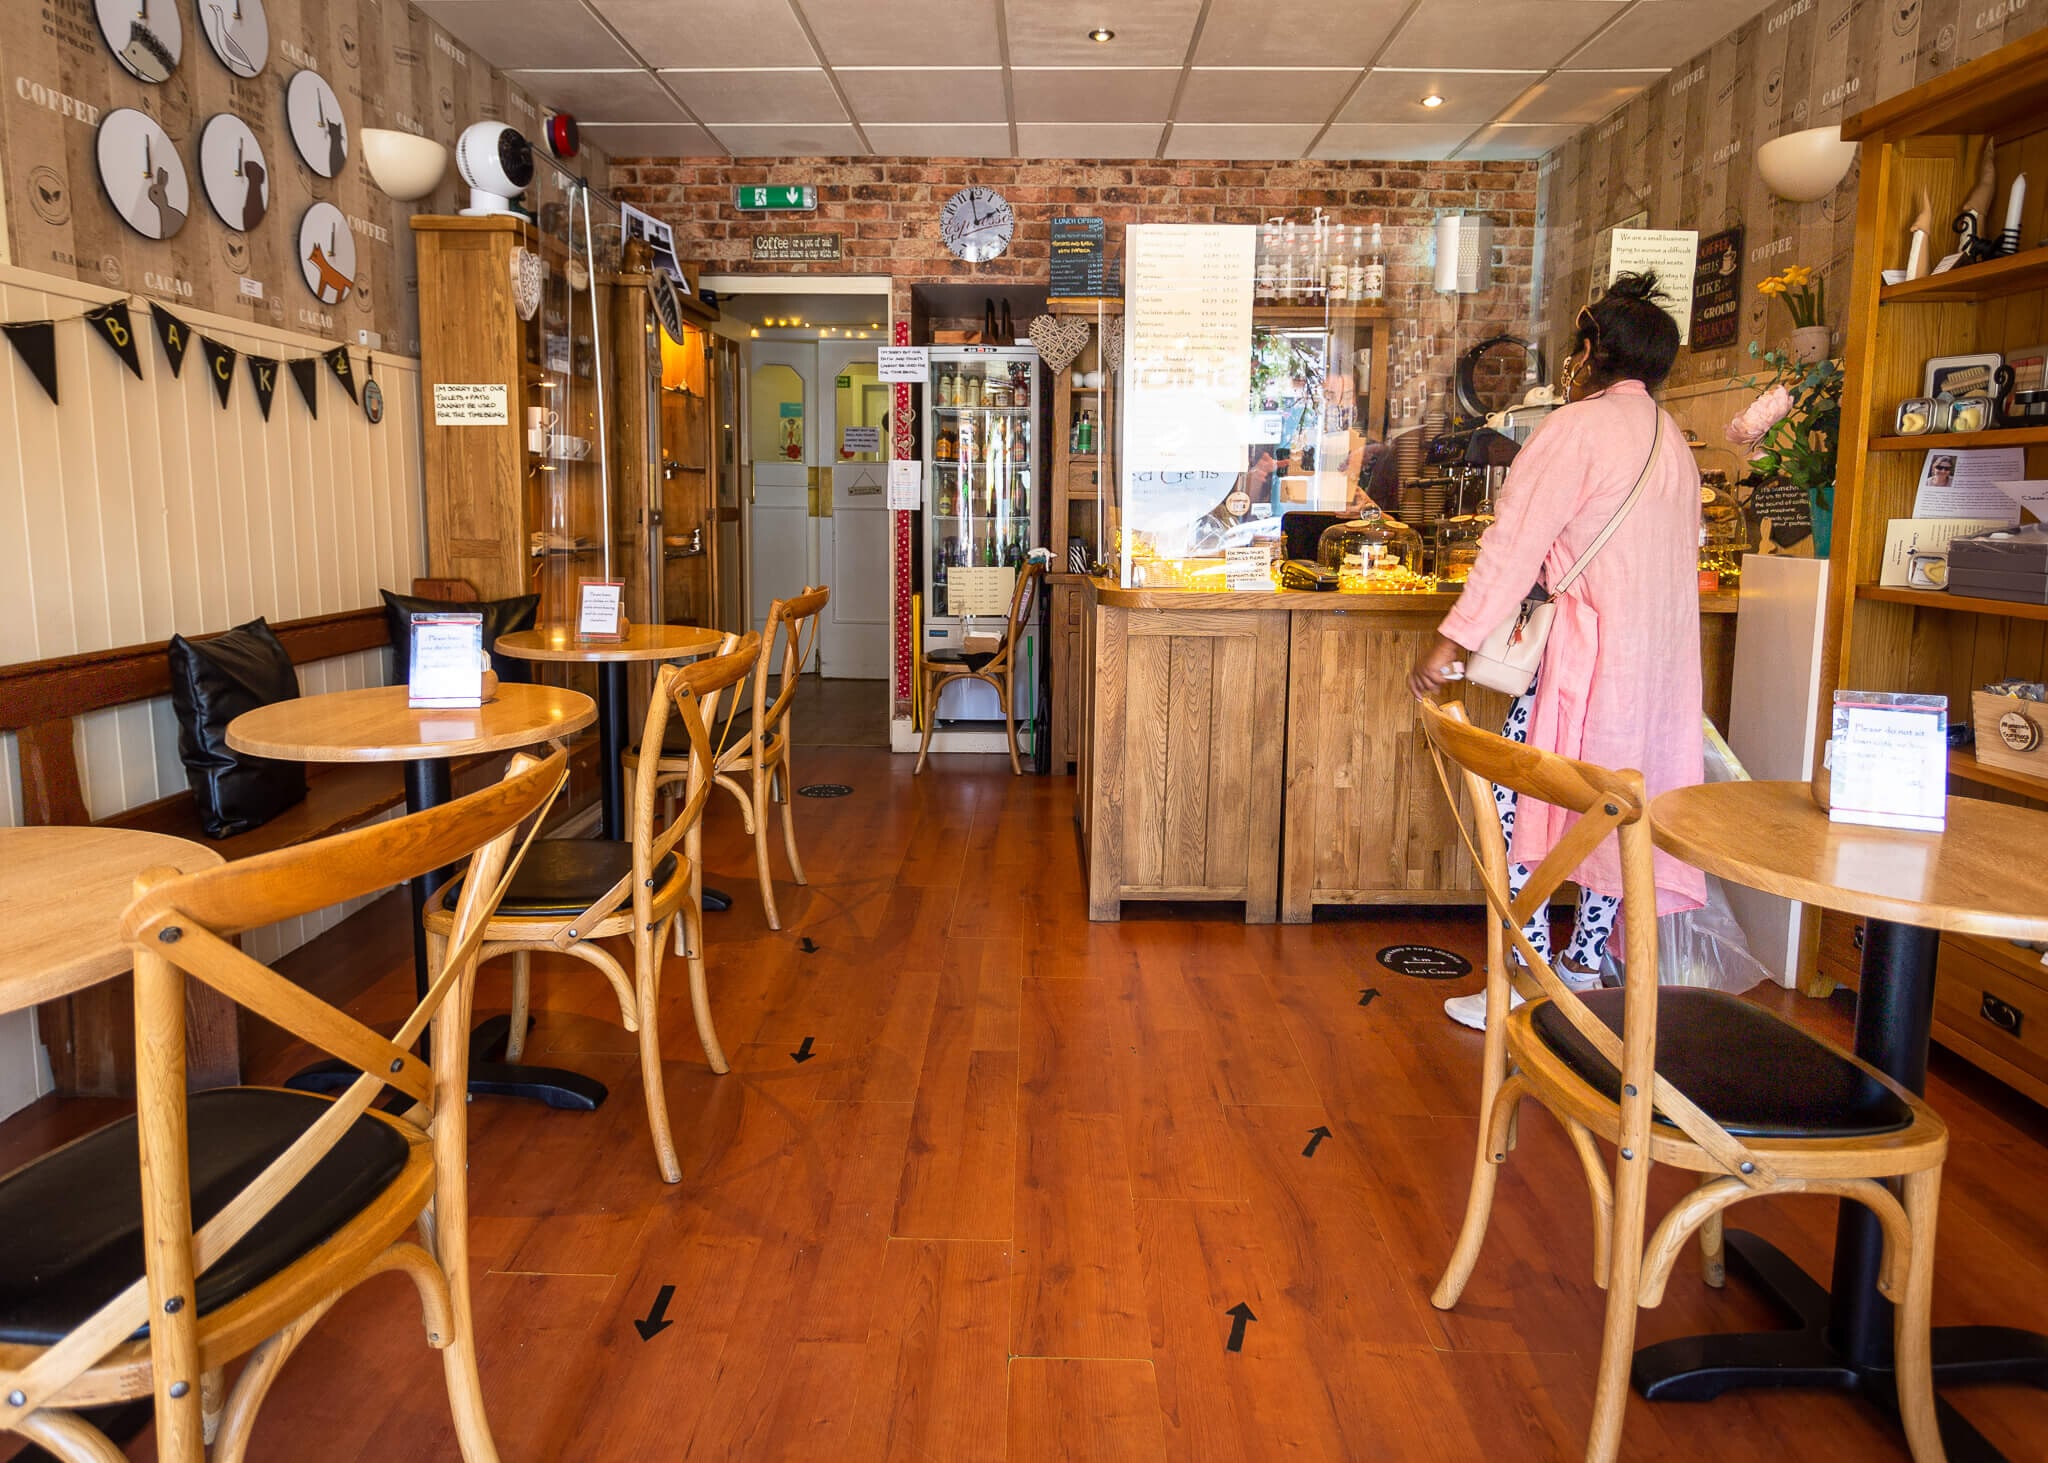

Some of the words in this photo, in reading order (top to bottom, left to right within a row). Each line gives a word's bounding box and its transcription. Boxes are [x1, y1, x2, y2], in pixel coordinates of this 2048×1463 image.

[1767, 0, 1816, 34] COFFEE
[281, 39, 318, 71] CACAO
[434, 32, 466, 67] COFFEE
[1671, 65, 1705, 96] COFFEE
[1822, 77, 1859, 107] CACAO
[16, 76, 100, 127] COFFEE
[396, 111, 424, 136] CACAO
[1713, 141, 1741, 162] CACAO
[347, 214, 388, 243] COFFEE
[945, 214, 1010, 239] Espresso
[1055, 217, 1076, 225] LUNCH
[756, 236, 789, 250] Coffee
[1620, 233, 1631, 241] We
[1662, 234, 1689, 242] business
[1667, 246, 1691, 254] difficult
[1751, 236, 1793, 263] COFFEE
[144, 271, 193, 297] CACAO
[1695, 280, 1721, 298] LIKE
[299, 308, 334, 329] CACAO
[1703, 301, 1736, 319] GROUND
[472, 385, 486, 393] BUT
[489, 385, 506, 393] OUR
